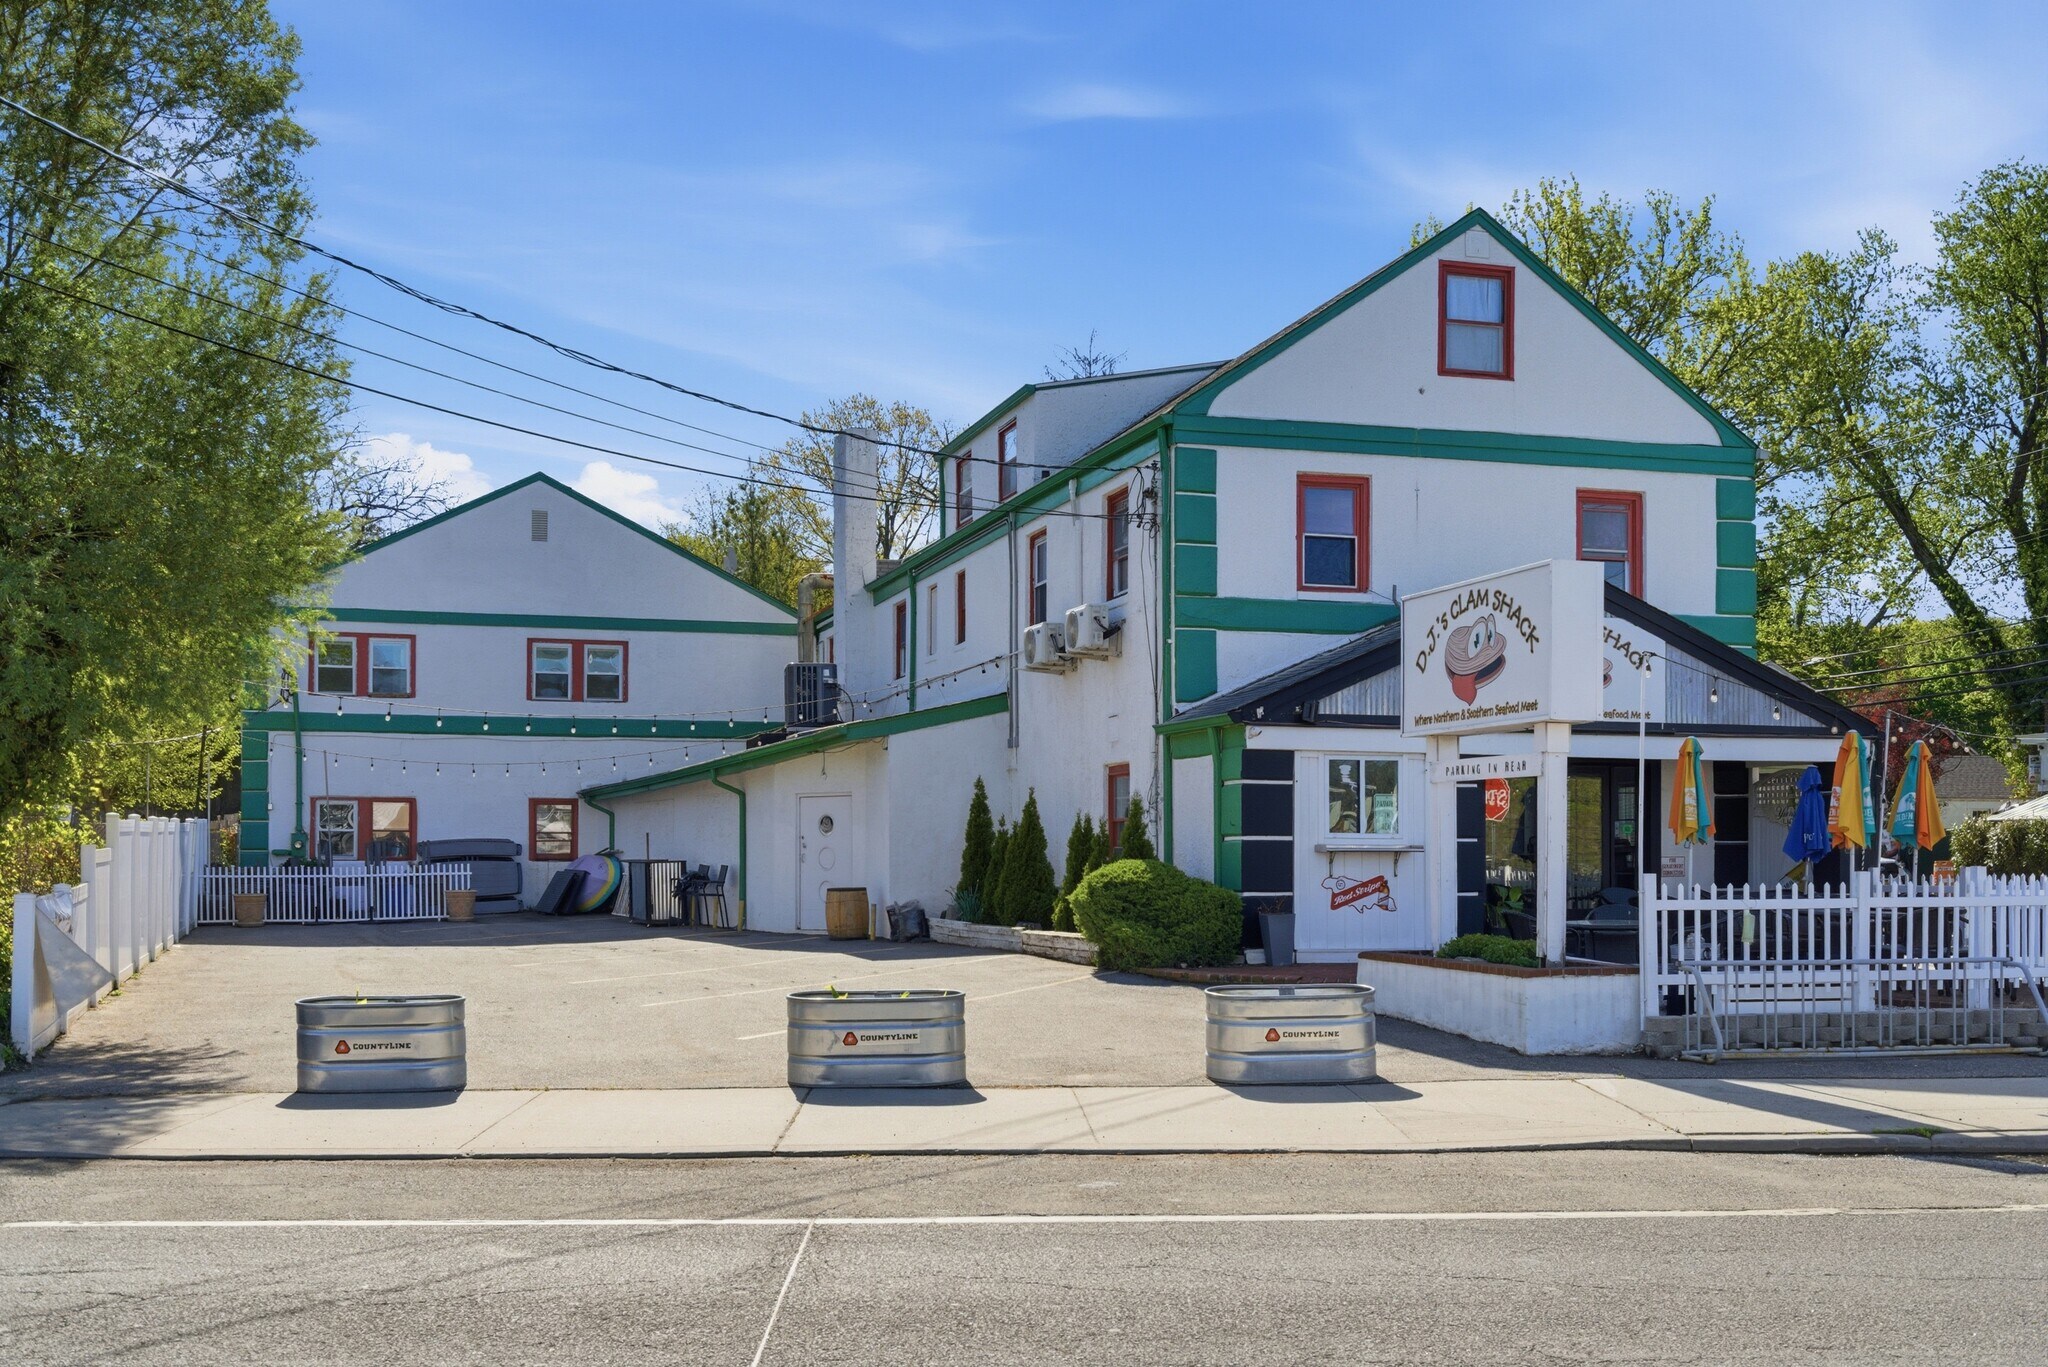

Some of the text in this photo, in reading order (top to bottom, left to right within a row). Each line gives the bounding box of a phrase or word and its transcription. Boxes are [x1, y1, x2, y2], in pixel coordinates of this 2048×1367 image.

[1450, 588, 1489, 620] CLAM
[1492, 589, 1540, 654] SHACK
[1414, 714, 1433, 727] Where
[1433, 710, 1460, 724] Northern
[1460, 708, 1466, 720] &
[1466, 705, 1494, 720] Southern
[1494, 701, 1520, 717] Seafood
[1603, 708, 1629, 719] eafood
[1445, 760, 1527, 777] PARKING IN REAR
[1333, 891, 1354, 906] Red
[1354, 881, 1383, 896] Stripe
